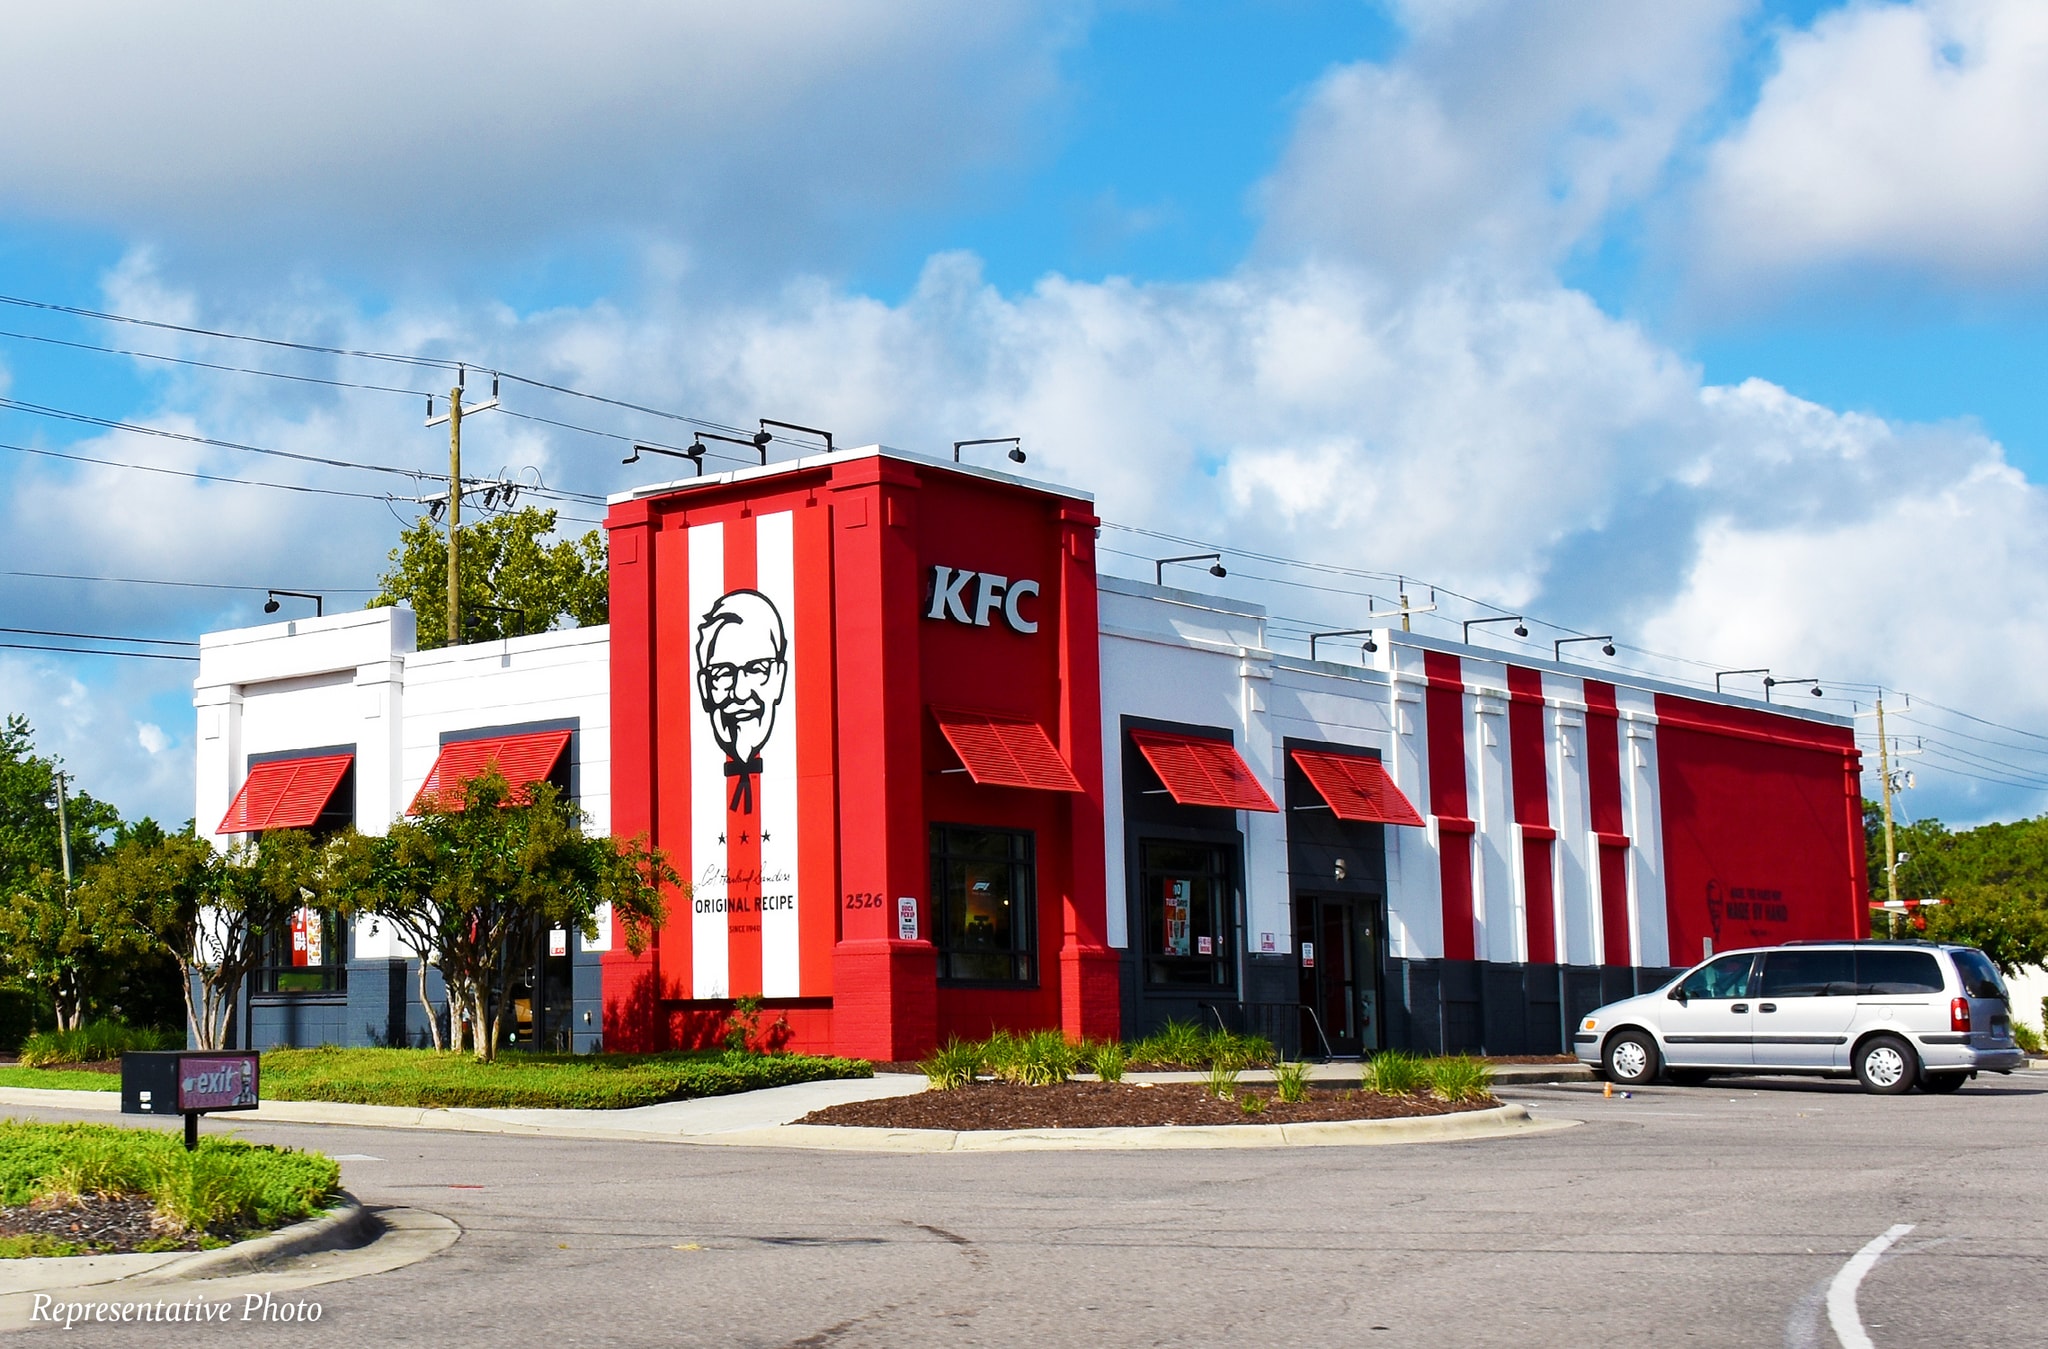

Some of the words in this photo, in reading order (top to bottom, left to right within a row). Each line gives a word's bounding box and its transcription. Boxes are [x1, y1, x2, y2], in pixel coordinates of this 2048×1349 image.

[927, 565, 1040, 634] KFC
[695, 897, 750, 913] ORIGINAL
[754, 895, 794, 911] RECIPE
[846, 892, 883, 910] 2526
[729, 925, 745, 933] SINCE
[198, 1065, 234, 1094] exit
